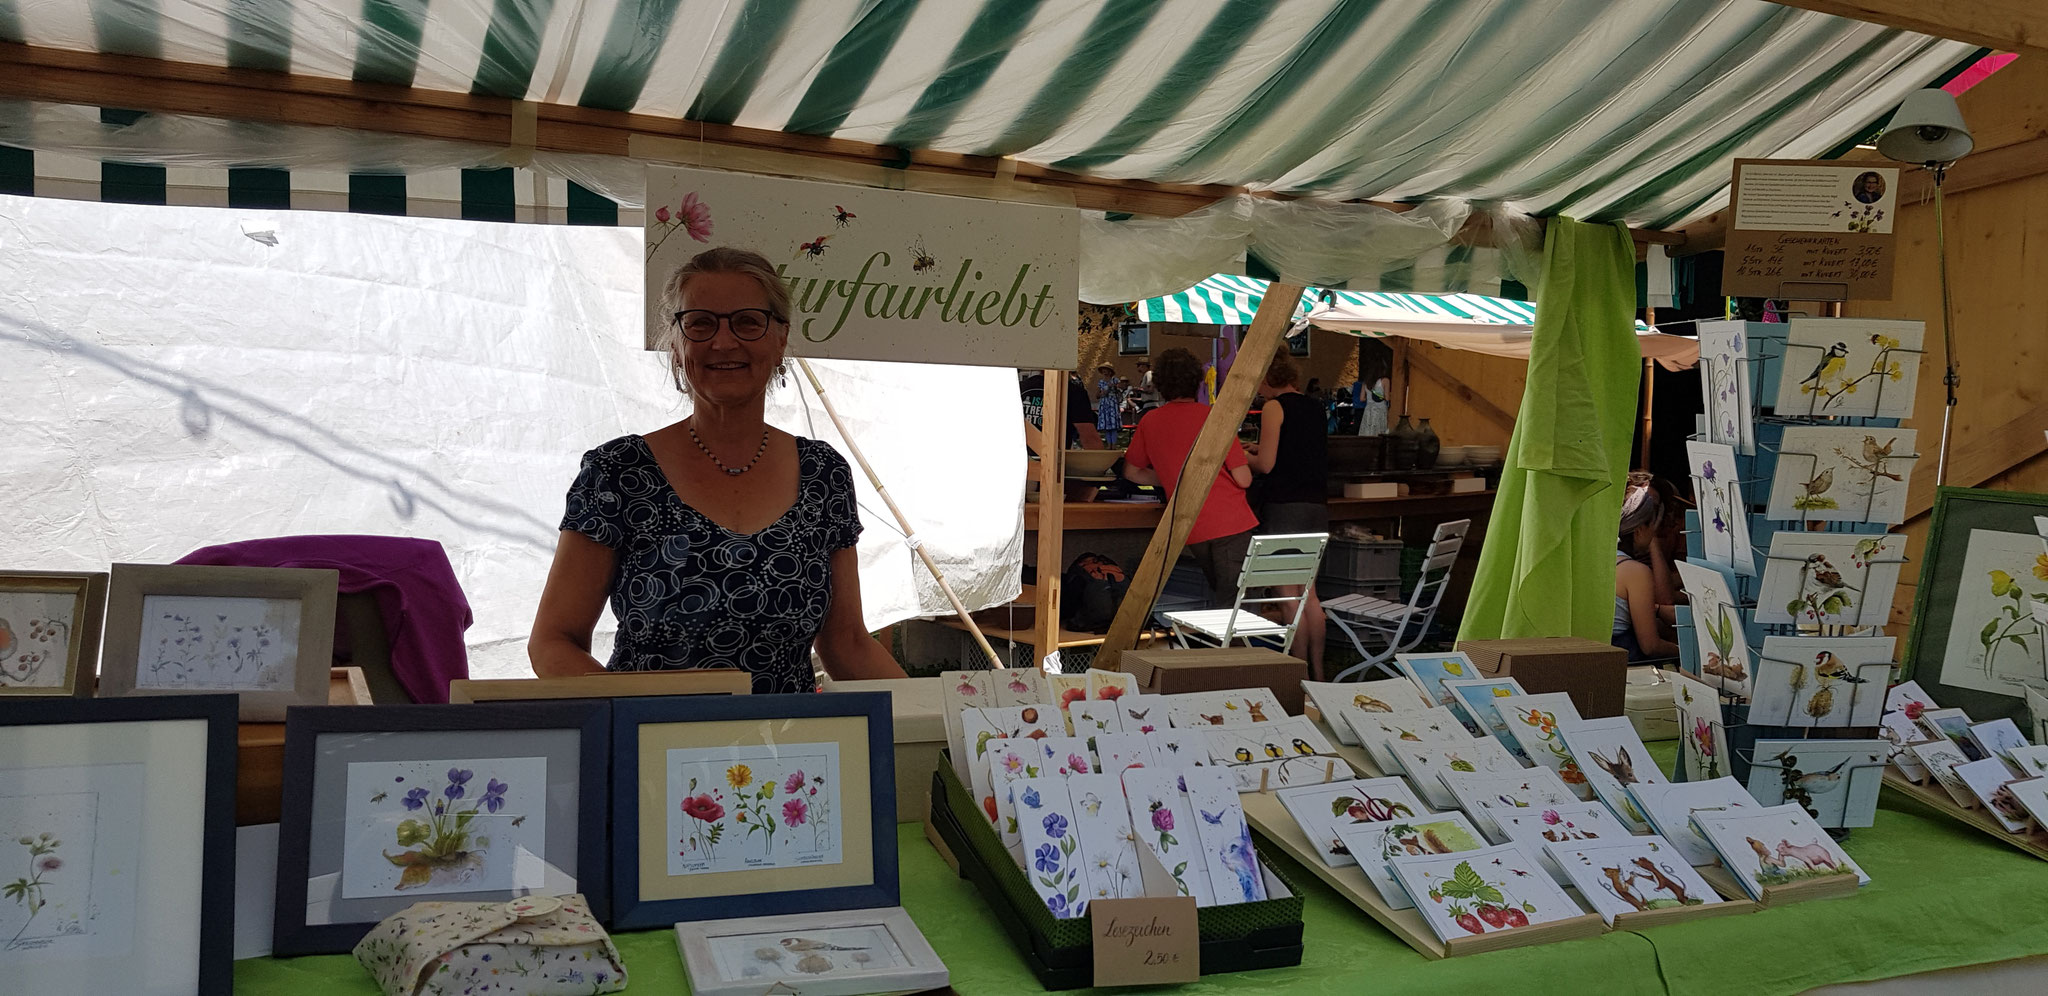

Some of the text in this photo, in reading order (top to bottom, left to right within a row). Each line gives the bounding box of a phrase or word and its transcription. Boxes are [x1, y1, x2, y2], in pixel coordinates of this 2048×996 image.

[776, 251, 1056, 343] urfairliebt
[1031, 396, 1044, 406] IS
[1104, 916, 1172, 948] Lesezeichen
